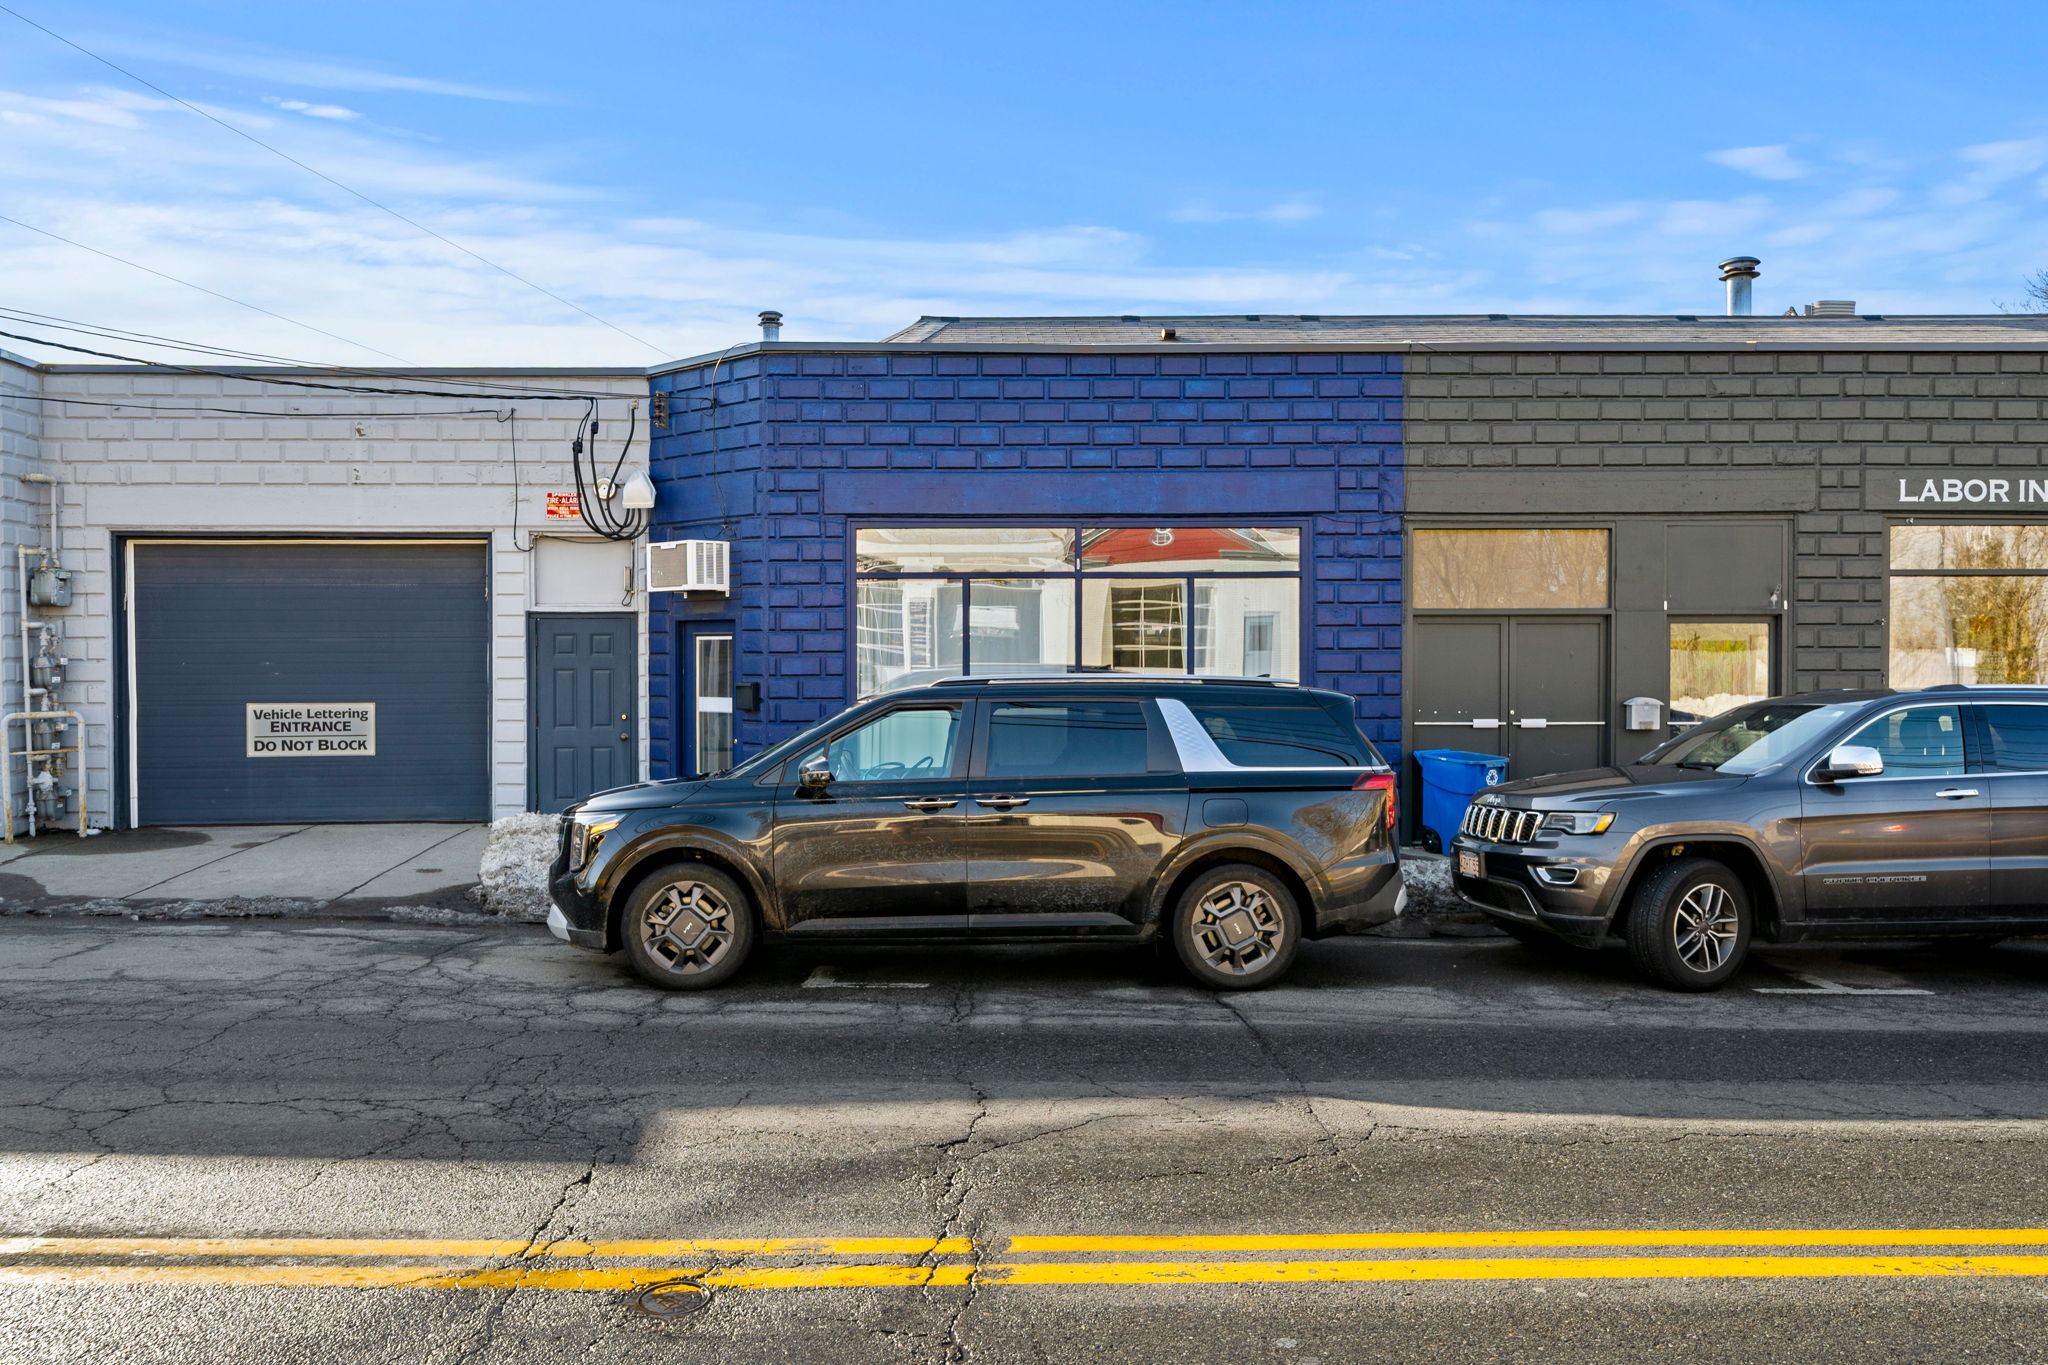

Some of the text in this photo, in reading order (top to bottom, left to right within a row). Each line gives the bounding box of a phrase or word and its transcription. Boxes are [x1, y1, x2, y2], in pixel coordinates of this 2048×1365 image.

[1899, 478, 2010, 503] LABOR
[253, 708, 369, 722] Vehicle Lettering
[270, 721, 352, 733] ENTRANCE
[254, 739, 368, 752] DO NOT BLOCK
